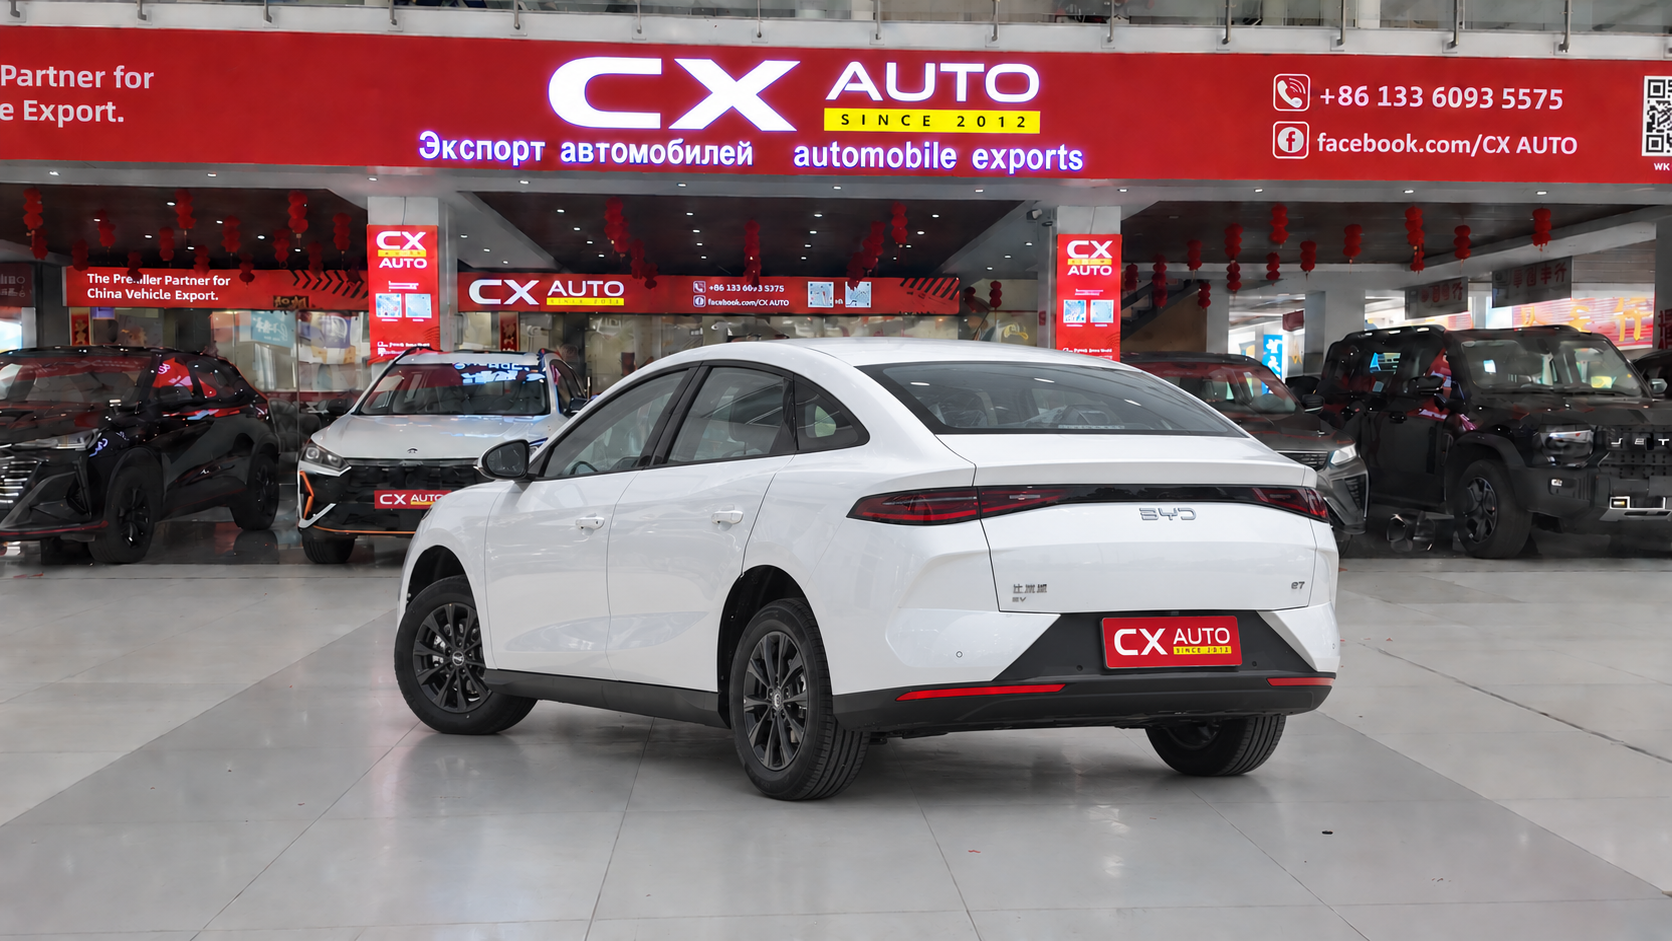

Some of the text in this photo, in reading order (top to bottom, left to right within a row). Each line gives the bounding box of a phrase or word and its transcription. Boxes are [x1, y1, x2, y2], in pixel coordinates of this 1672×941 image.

[1, 65, 154, 88] Partner for
[549, 57, 1039, 131] CX AUTO
[1320, 86, 1563, 110] +86 133 6093 5575
[24, 100, 124, 127] Export.
[841, 113, 1025, 128] SINCE 2012
[419, 131, 753, 166] Экспорт автомобилей
[1317, 133, 1578, 158] facebook.com/CX AUTO
[794, 142, 1083, 174] automobile exports
[376, 231, 426, 250] CX
[1067, 240, 1113, 258] CX
[379, 257, 427, 268] AUTO
[1067, 265, 1112, 275] AUTO
[87, 273, 110, 284] The
[164, 275, 211, 286] Partner
[213, 275, 231, 286] for
[709, 284, 725, 292] +86
[726, 284, 741, 292] 133
[87, 288, 219, 303] China Vehicle Export.
[468, 279, 625, 305] CX AUTO
[769, 299, 790, 307] AUTO
[379, 493, 407, 505] CX
[1139, 507, 1197, 521] BYD
[1291, 581, 1306, 589] e7
[1113, 627, 1231, 656] CX AUTO
